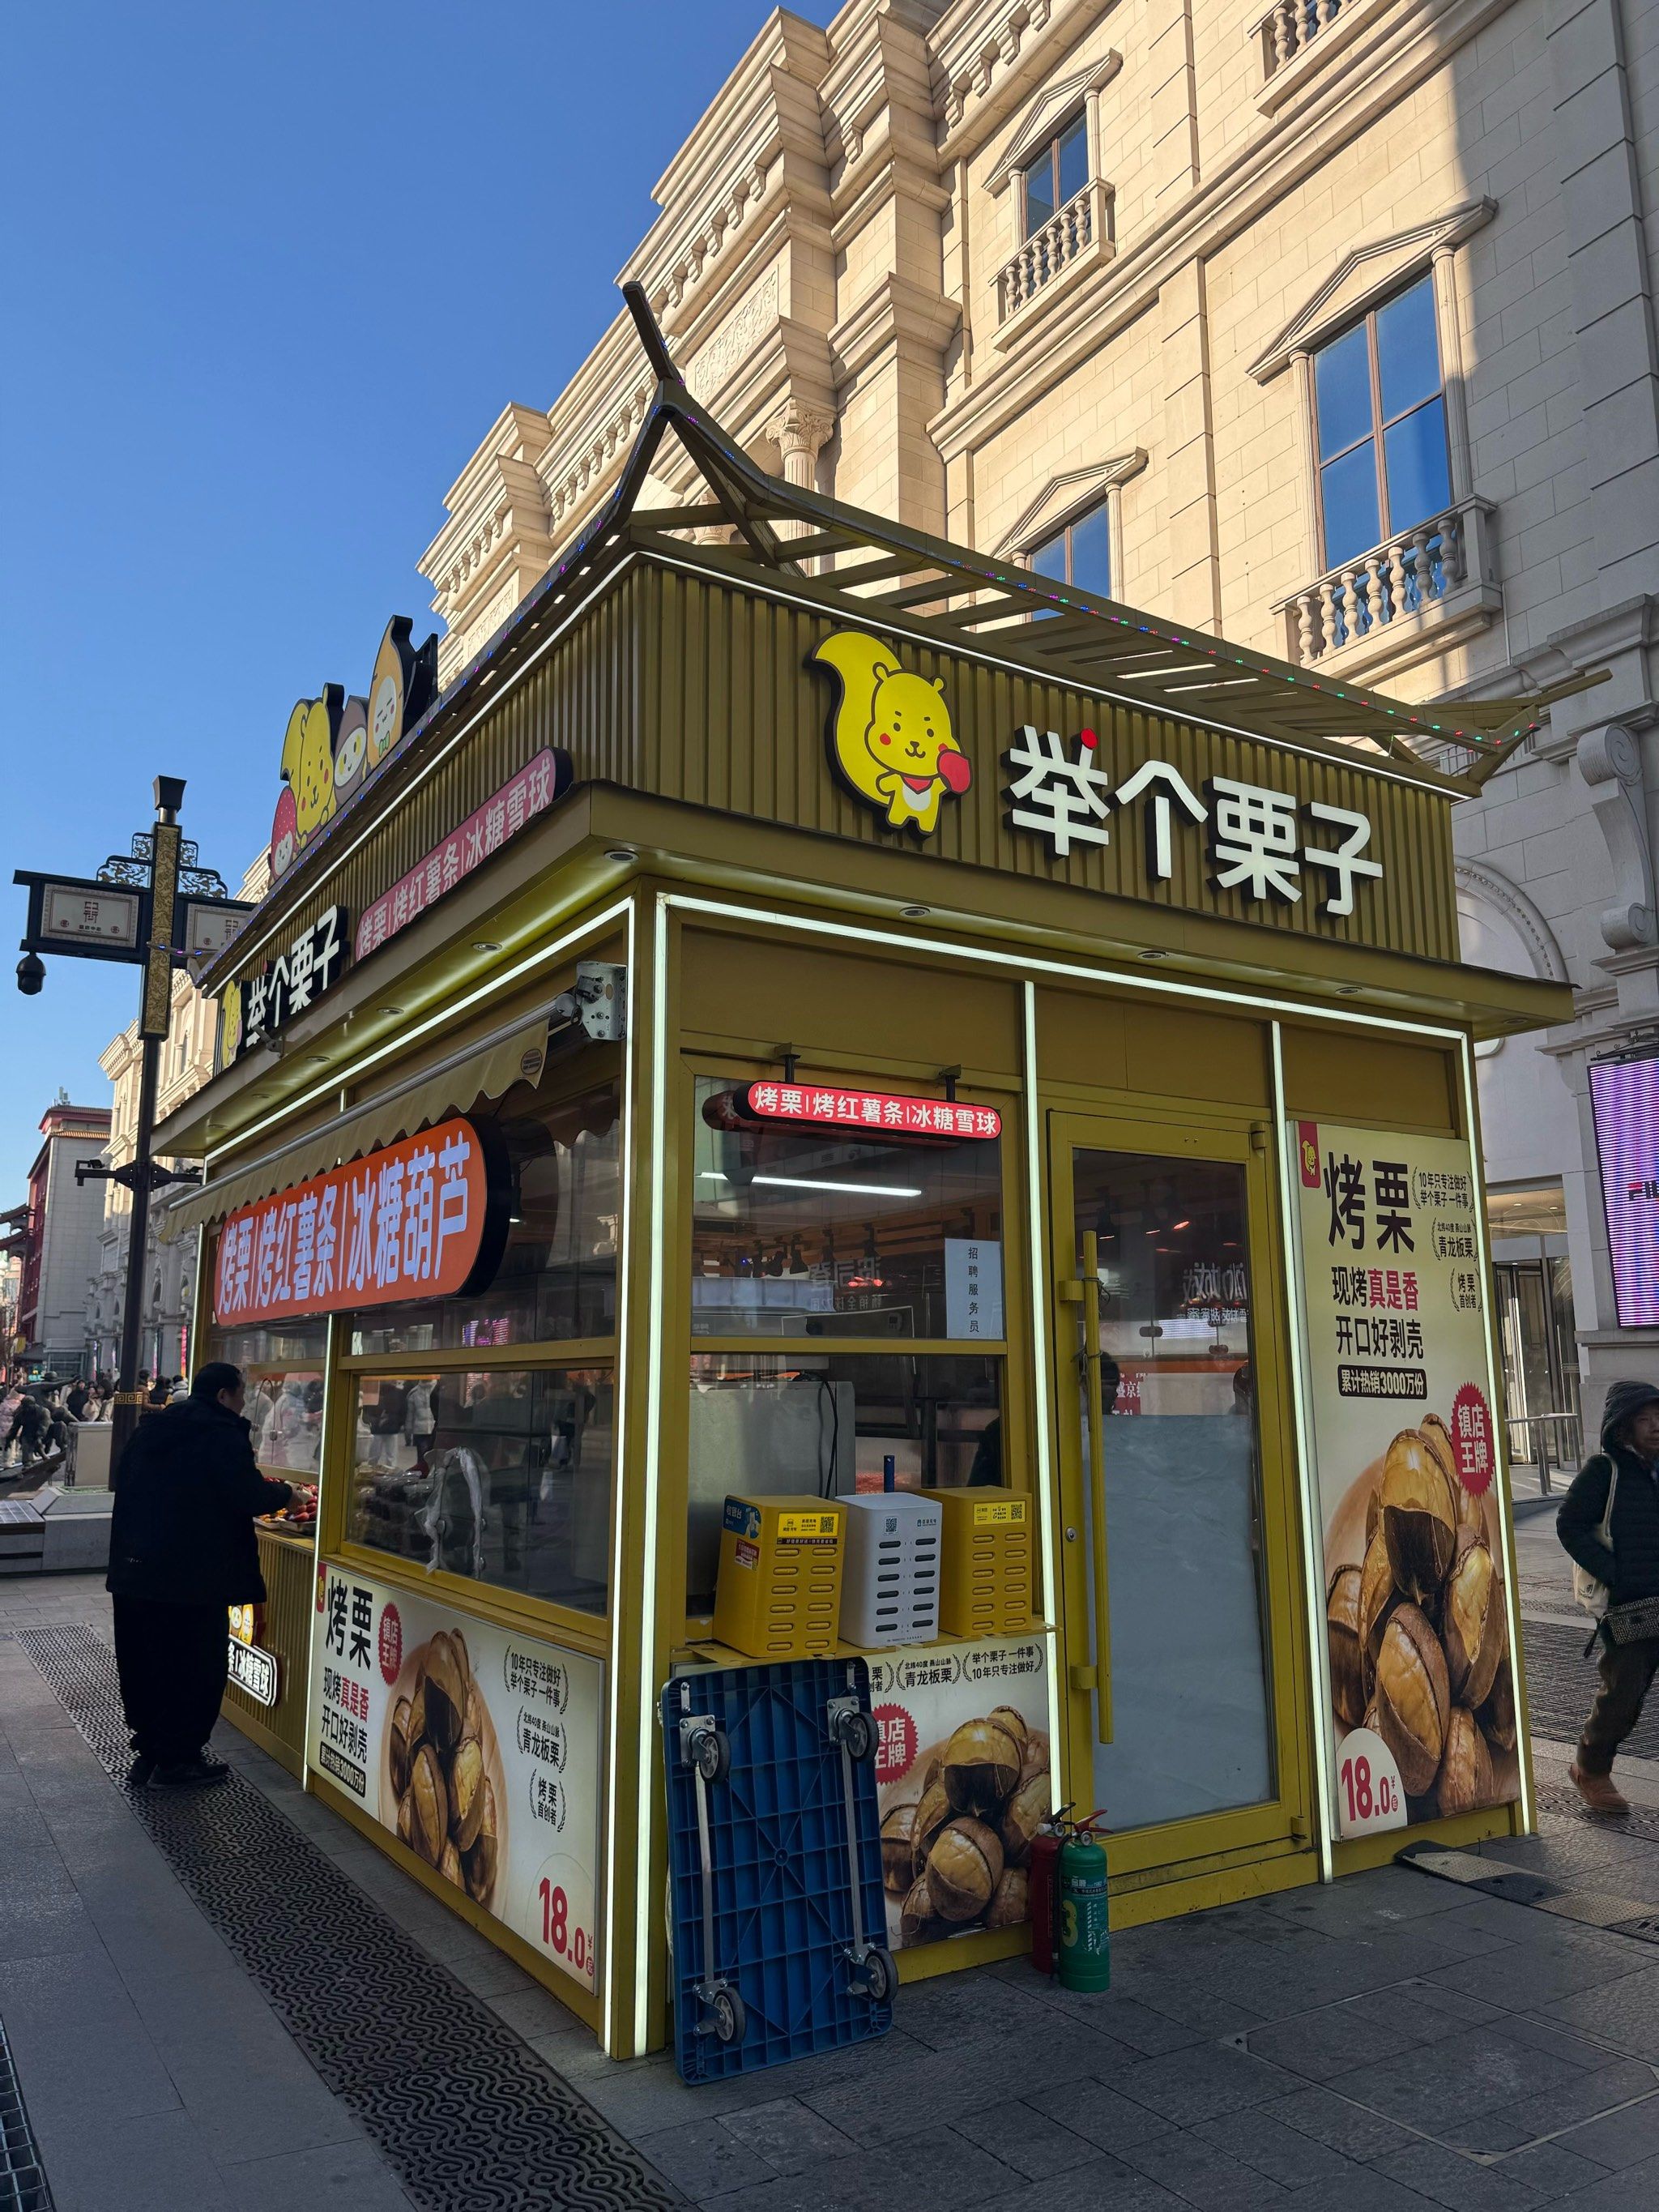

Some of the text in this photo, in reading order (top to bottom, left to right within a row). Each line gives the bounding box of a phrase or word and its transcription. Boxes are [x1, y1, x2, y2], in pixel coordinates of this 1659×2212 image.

[1009, 724, 1384, 916] 举个栗子
[245, 904, 339, 1048] 举个栗子
[1323, 1151, 1415, 1255] 烤栗
[1438, 1236, 1474, 1258] 青龙板栗
[967, 1247, 980, 1333] 招聘服务员
[1331, 1266, 1419, 1312] 现烤真是香
[1457, 1273, 1476, 1294] 烤栗
[1335, 1315, 1424, 1360] 开口好剥壳
[1341, 1369, 1424, 1397] 累计热销3000万份
[1457, 1403, 1486, 1439] 镇店
[1461, 1441, 1489, 1475] 王牌
[326, 1576, 373, 1671] 烤栗
[904, 1667, 953, 1689] 青龙板栗
[971, 1661, 1034, 1680] 10年只专注做好
[323, 1666, 369, 1723] 现烤真是香
[322, 1704, 368, 1764] 开口好剥壳
[522, 1728, 560, 1768] 青龙板栗
[538, 1776, 557, 1808] 烤栗
[1341, 1755, 1390, 1821] 18.0
[539, 1877, 586, 1970] 18.0
